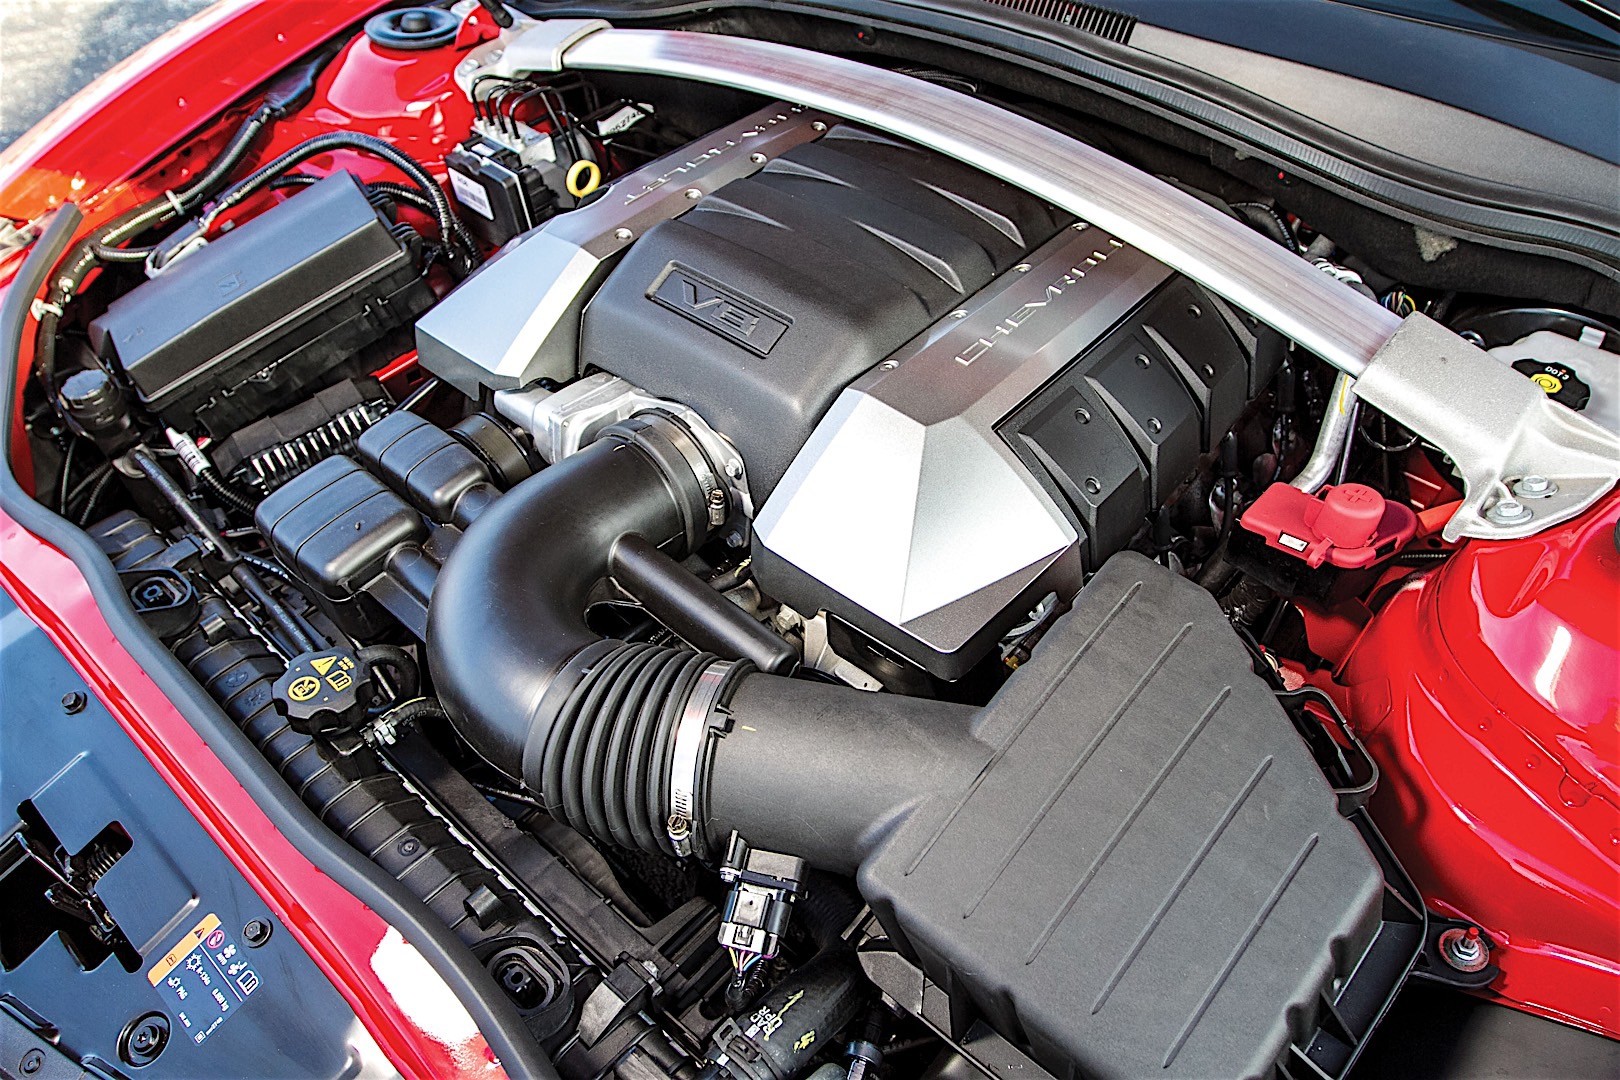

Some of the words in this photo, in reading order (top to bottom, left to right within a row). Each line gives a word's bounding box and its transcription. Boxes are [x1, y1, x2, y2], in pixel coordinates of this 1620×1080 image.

[624, 103, 809, 206] HEVROLET
[682, 279, 761, 338] V8
[954, 238, 1124, 367] CHEVROL
